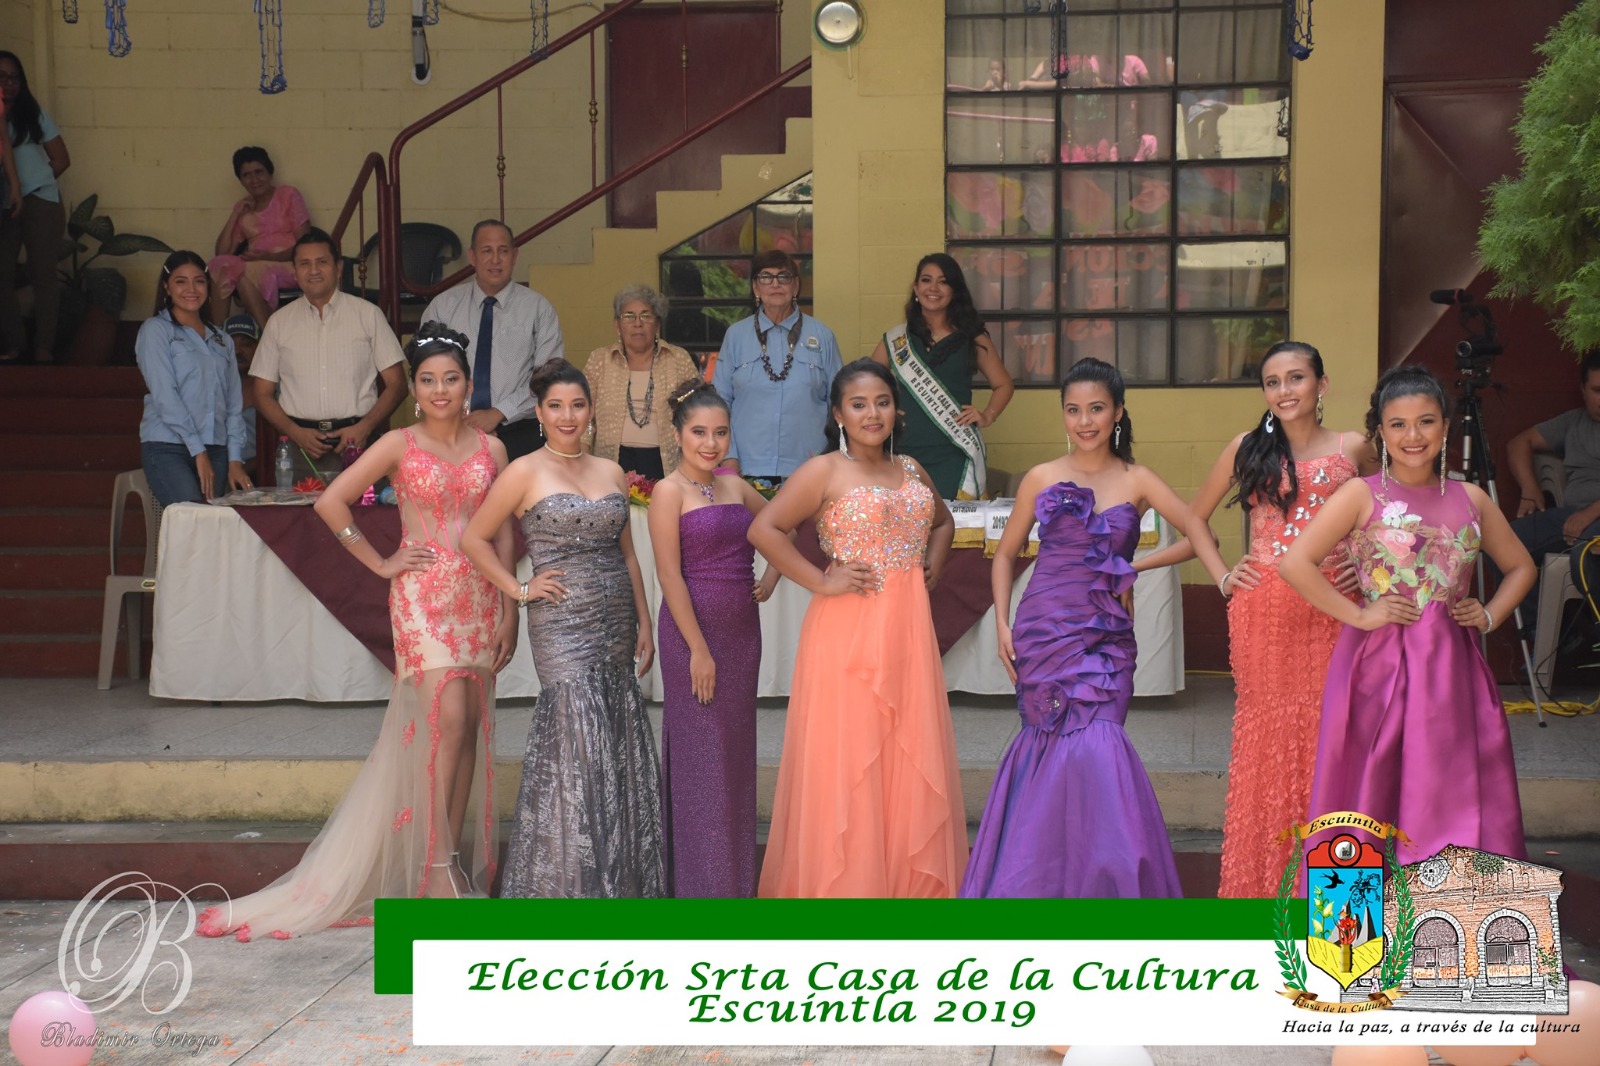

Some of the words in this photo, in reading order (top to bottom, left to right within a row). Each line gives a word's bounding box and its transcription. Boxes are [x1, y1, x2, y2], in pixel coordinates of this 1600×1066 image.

[908, 359, 925, 379] REINA
[922, 376, 932, 387] DE
[929, 384, 938, 396] LA
[937, 394, 951, 411] CASA
[910, 377, 944, 417] ESCUINTLA
